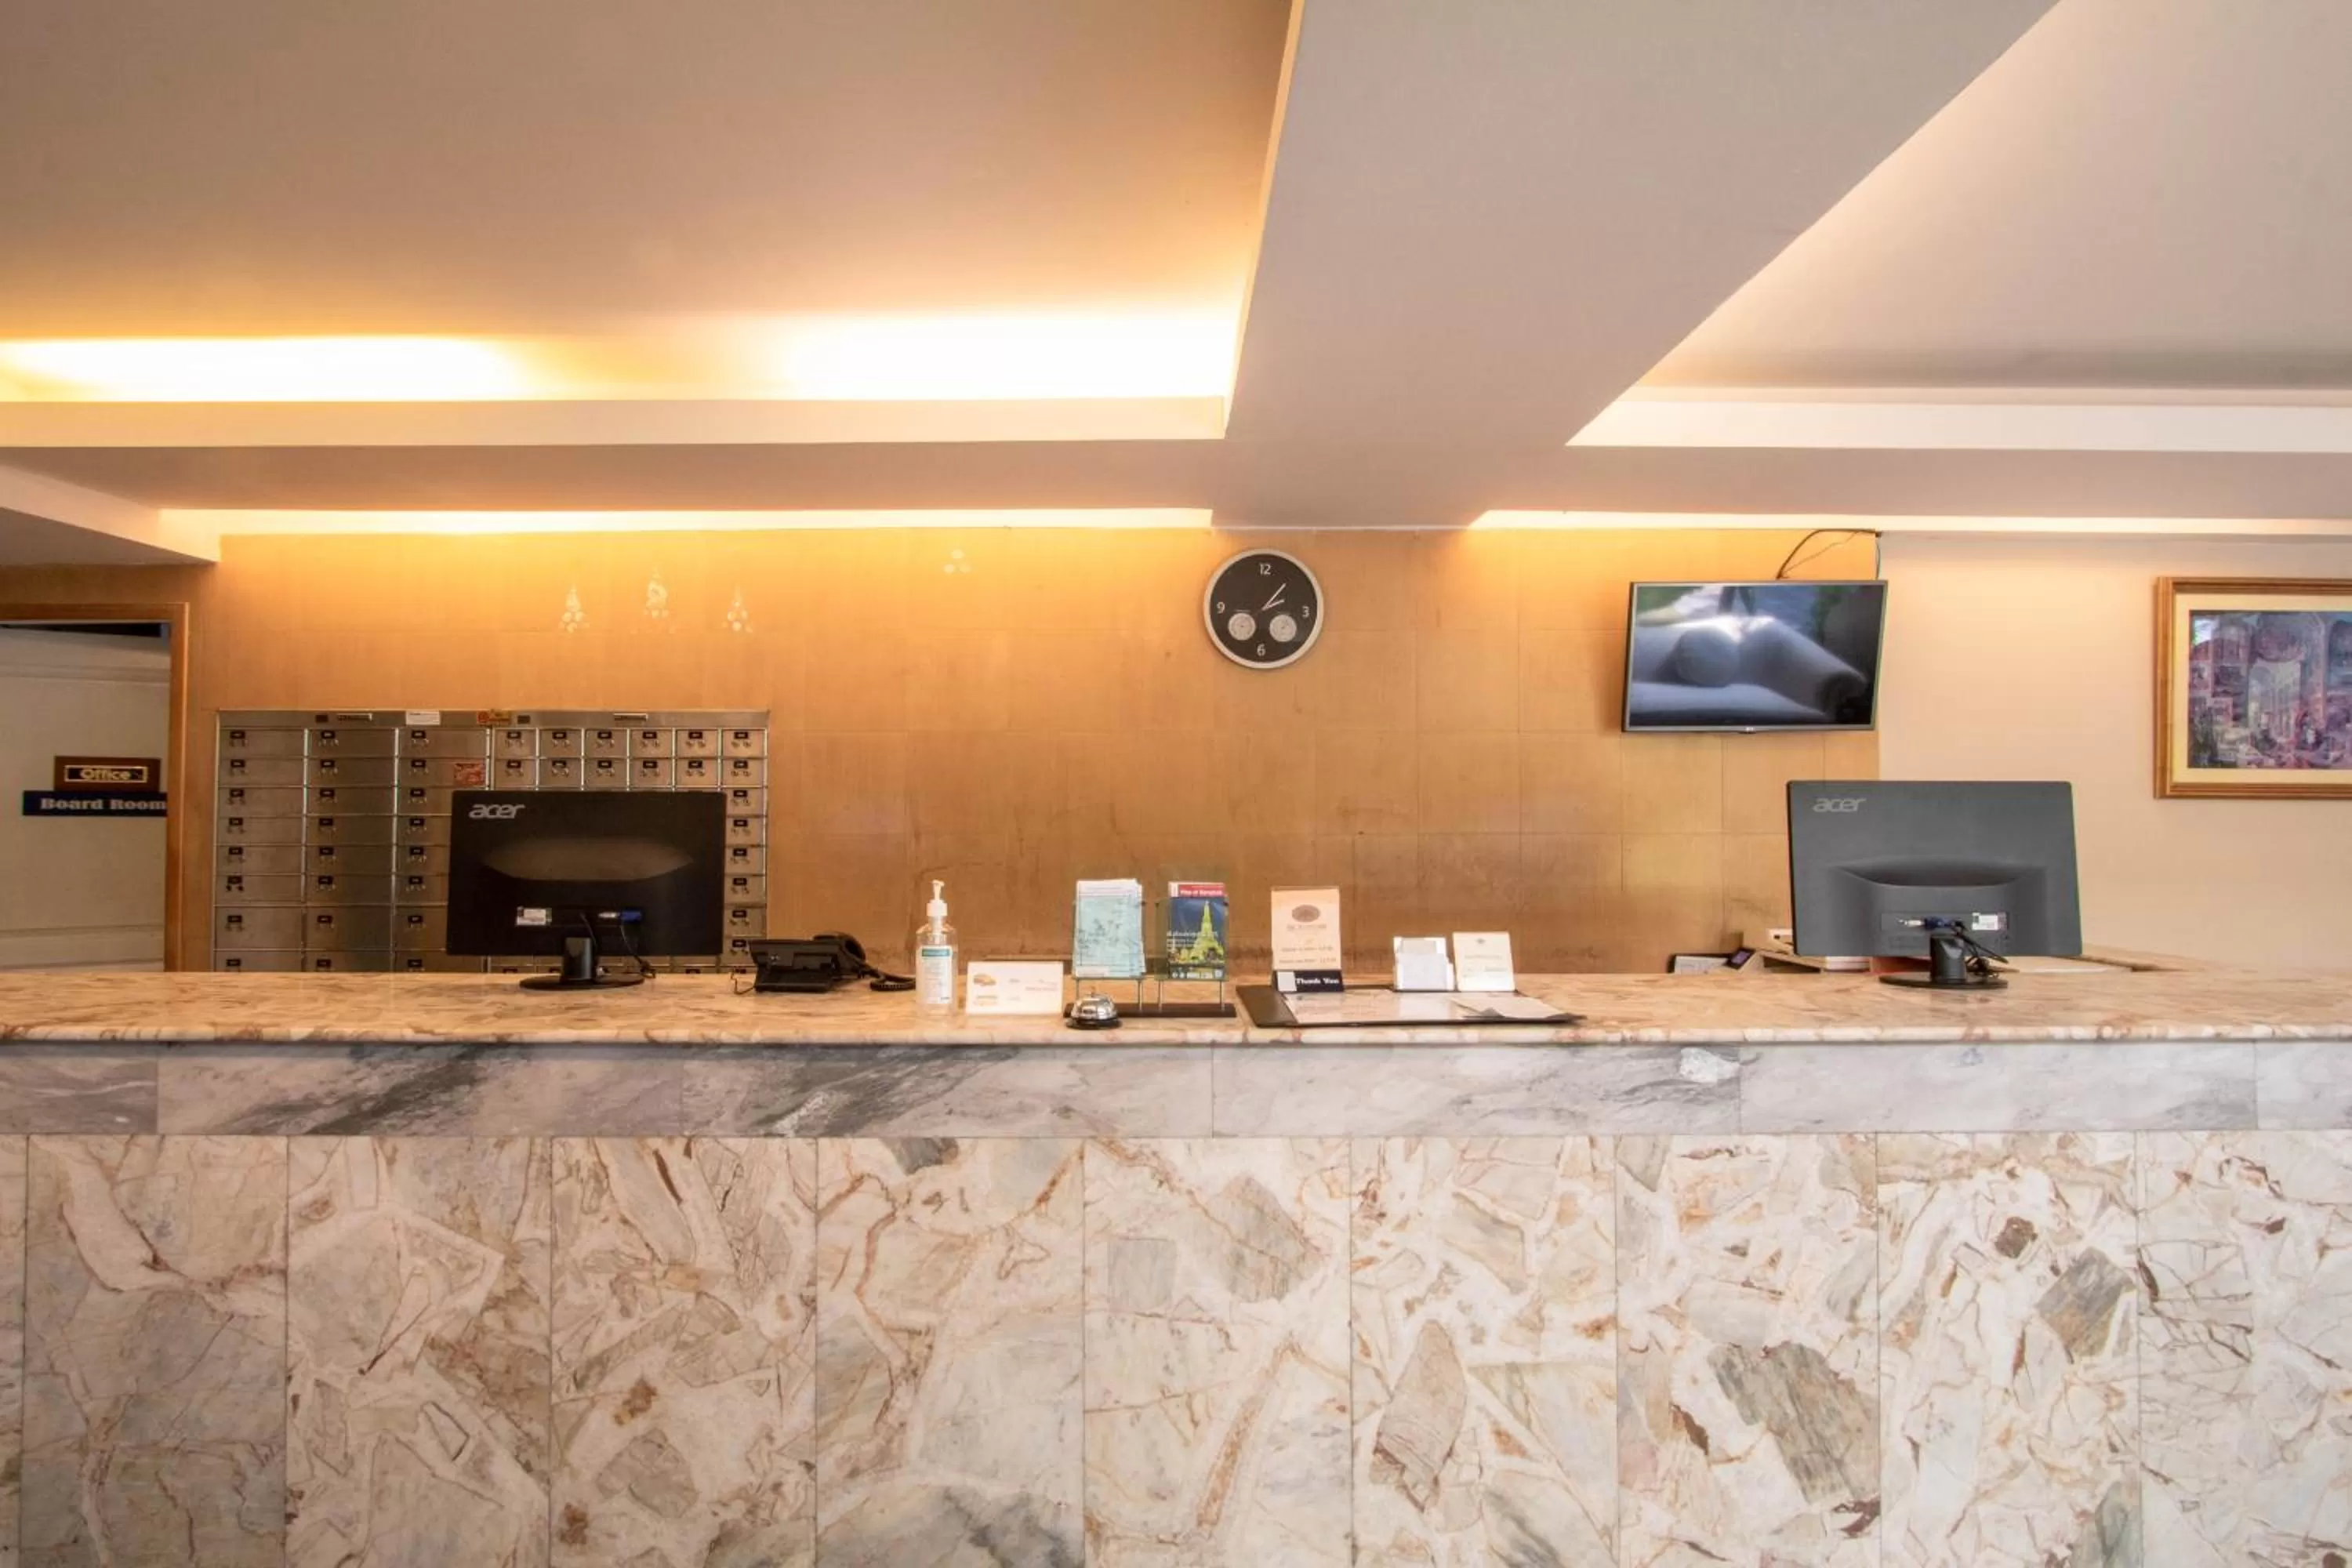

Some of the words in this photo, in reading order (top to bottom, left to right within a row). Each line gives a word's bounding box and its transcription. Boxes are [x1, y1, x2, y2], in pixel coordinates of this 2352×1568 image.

[1260, 564, 1272, 575] 12
[1217, 602, 1225, 613] 9
[1301, 606, 1310, 618] 3
[1257, 644, 1266, 656] 6
[80, 767, 132, 781] Office
[40, 797, 103, 810] Board
[109, 798, 166, 810] Room
[1812, 797, 1867, 813] acer
[469, 804, 525, 819] acer
